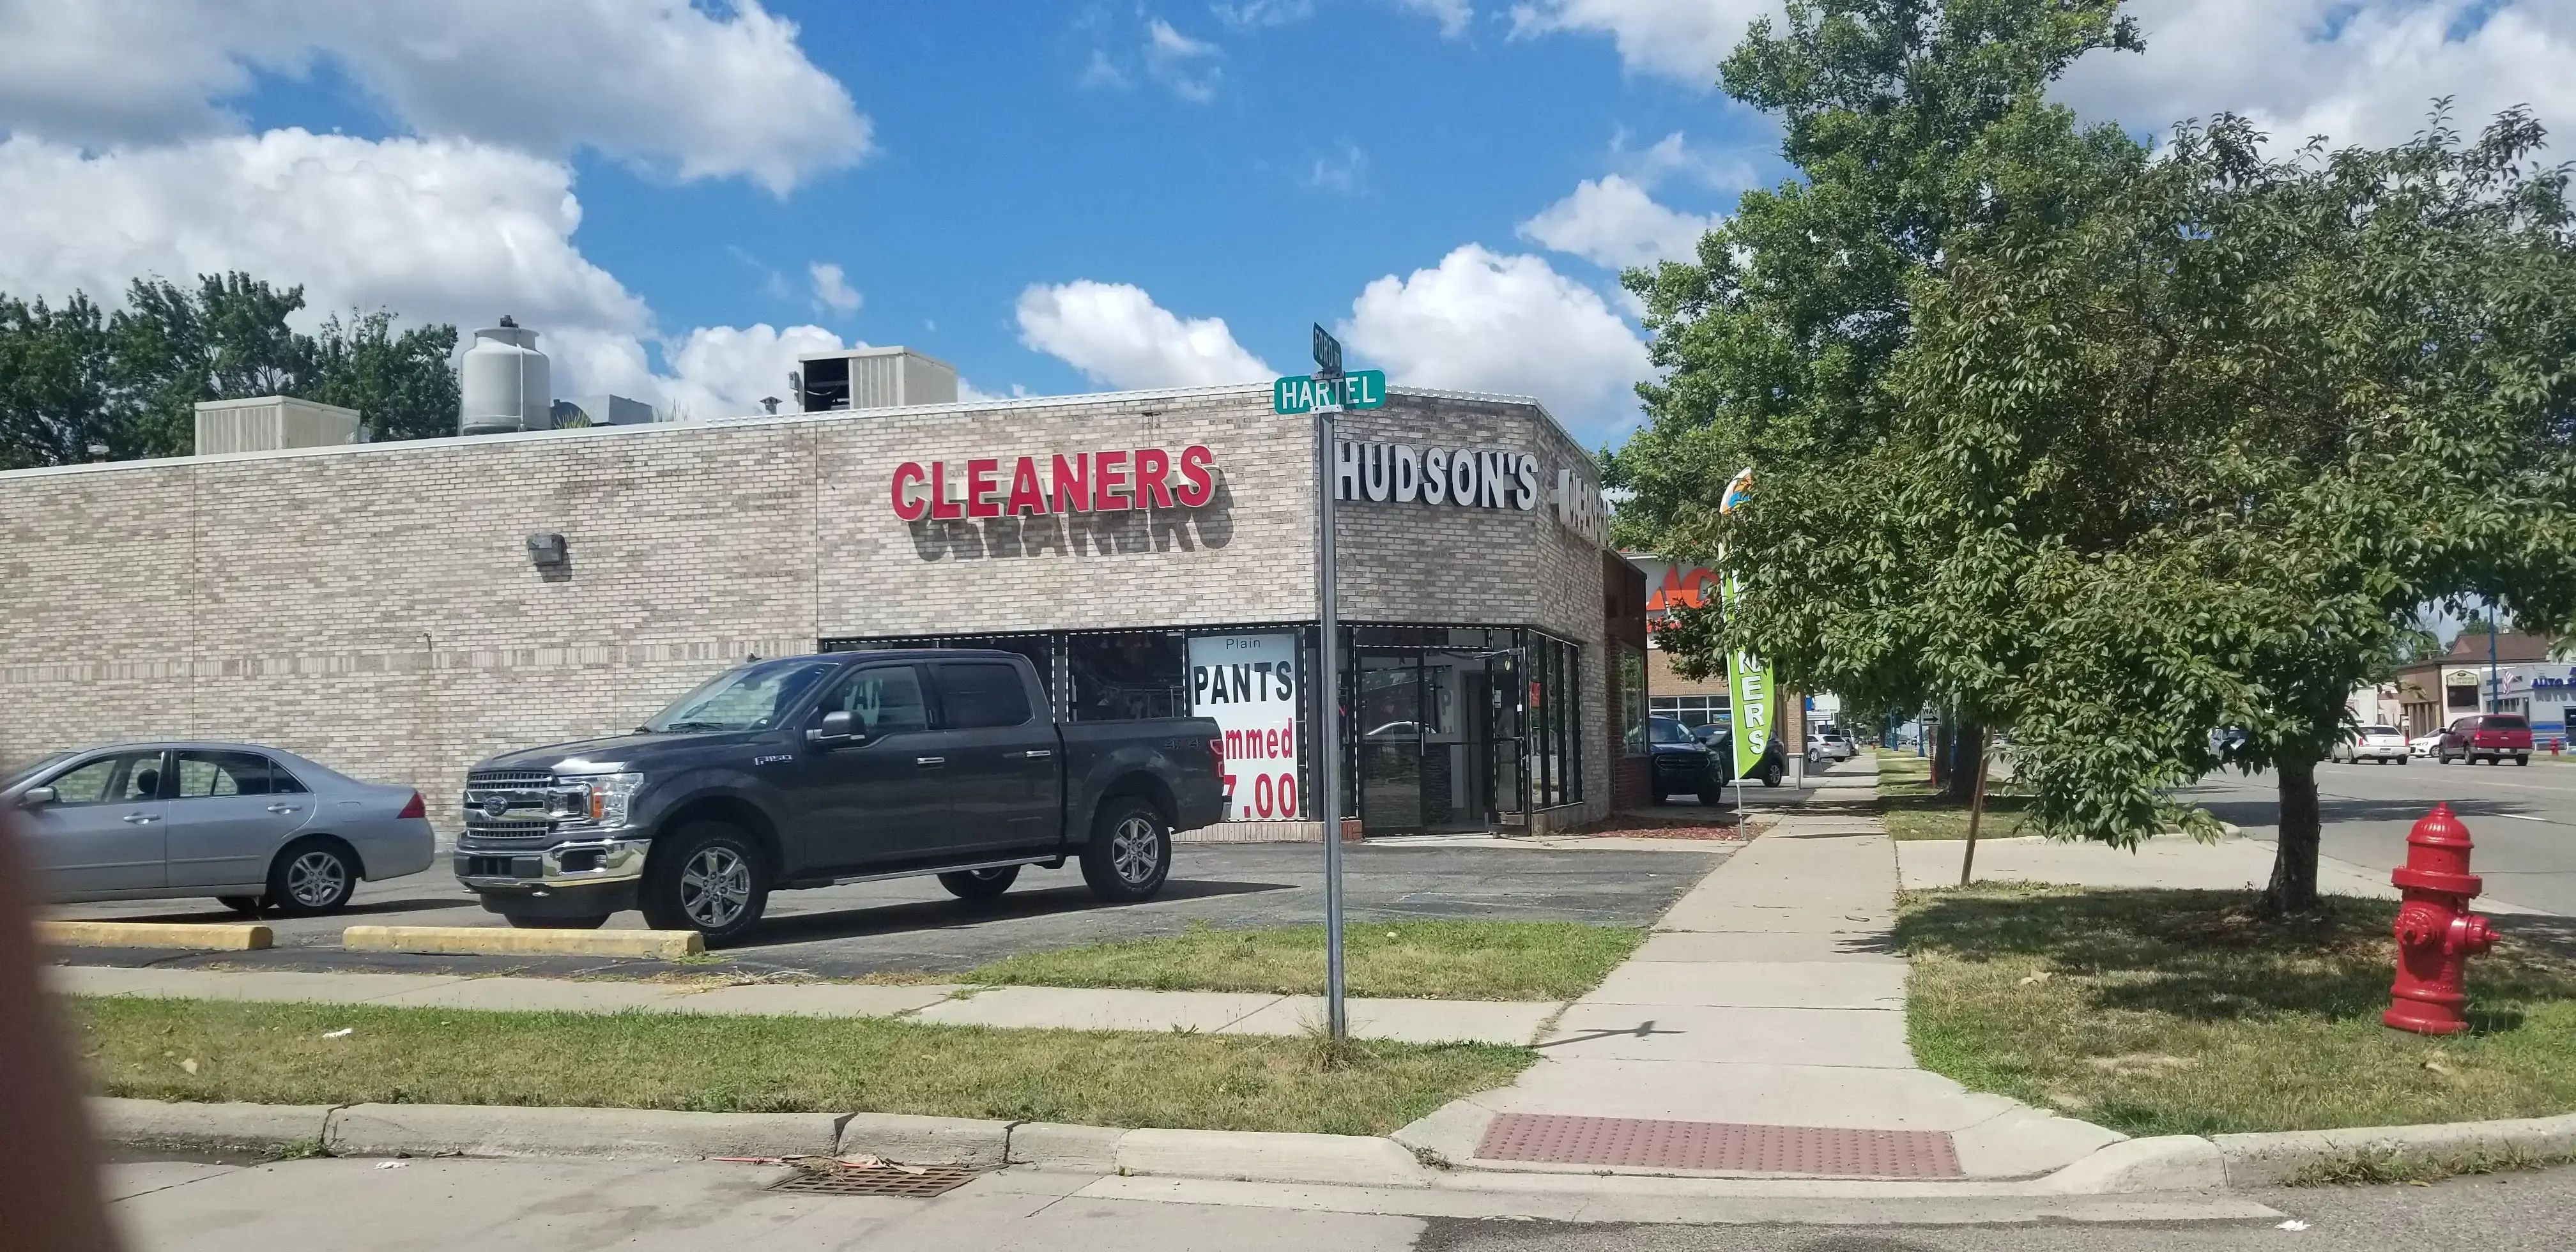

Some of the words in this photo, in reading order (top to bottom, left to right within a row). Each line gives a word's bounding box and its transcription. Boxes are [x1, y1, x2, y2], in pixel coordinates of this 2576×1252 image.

[1314, 328, 1333, 367] FORD
[1282, 376, 1377, 409] HARTEL
[891, 445, 1218, 522] CLEANERS
[1335, 441, 1538, 510] HUDSON'S
[1646, 564, 1721, 610] AC
[1226, 637, 1261, 650] Plain
[1193, 660, 1292, 705] PANTS
[1225, 717, 1293, 760] mmed
